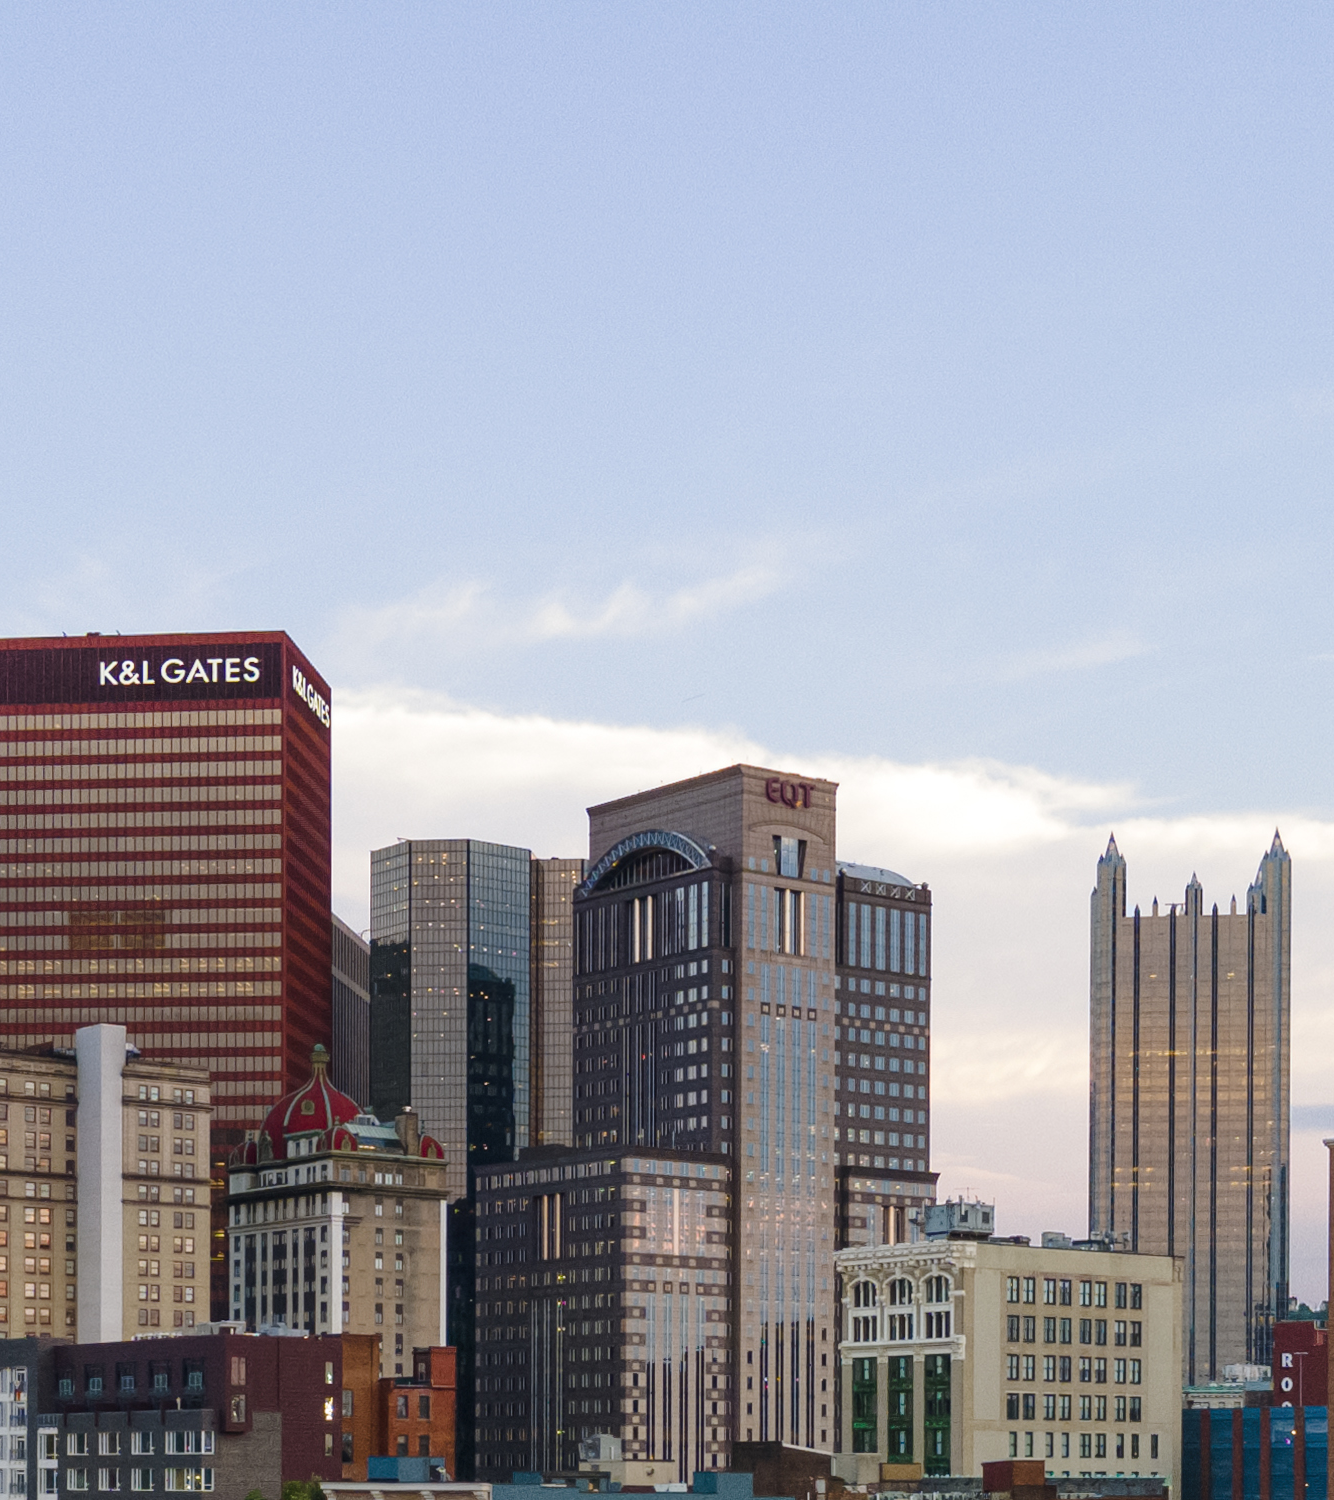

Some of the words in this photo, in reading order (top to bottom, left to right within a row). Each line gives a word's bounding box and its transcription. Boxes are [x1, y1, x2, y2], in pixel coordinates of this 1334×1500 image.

[99, 660, 155, 686] K&L
[160, 656, 260, 684] GATES
[292, 665, 308, 702] K&L
[307, 684, 330, 729] GATES
[765, 777, 816, 809] EQT
